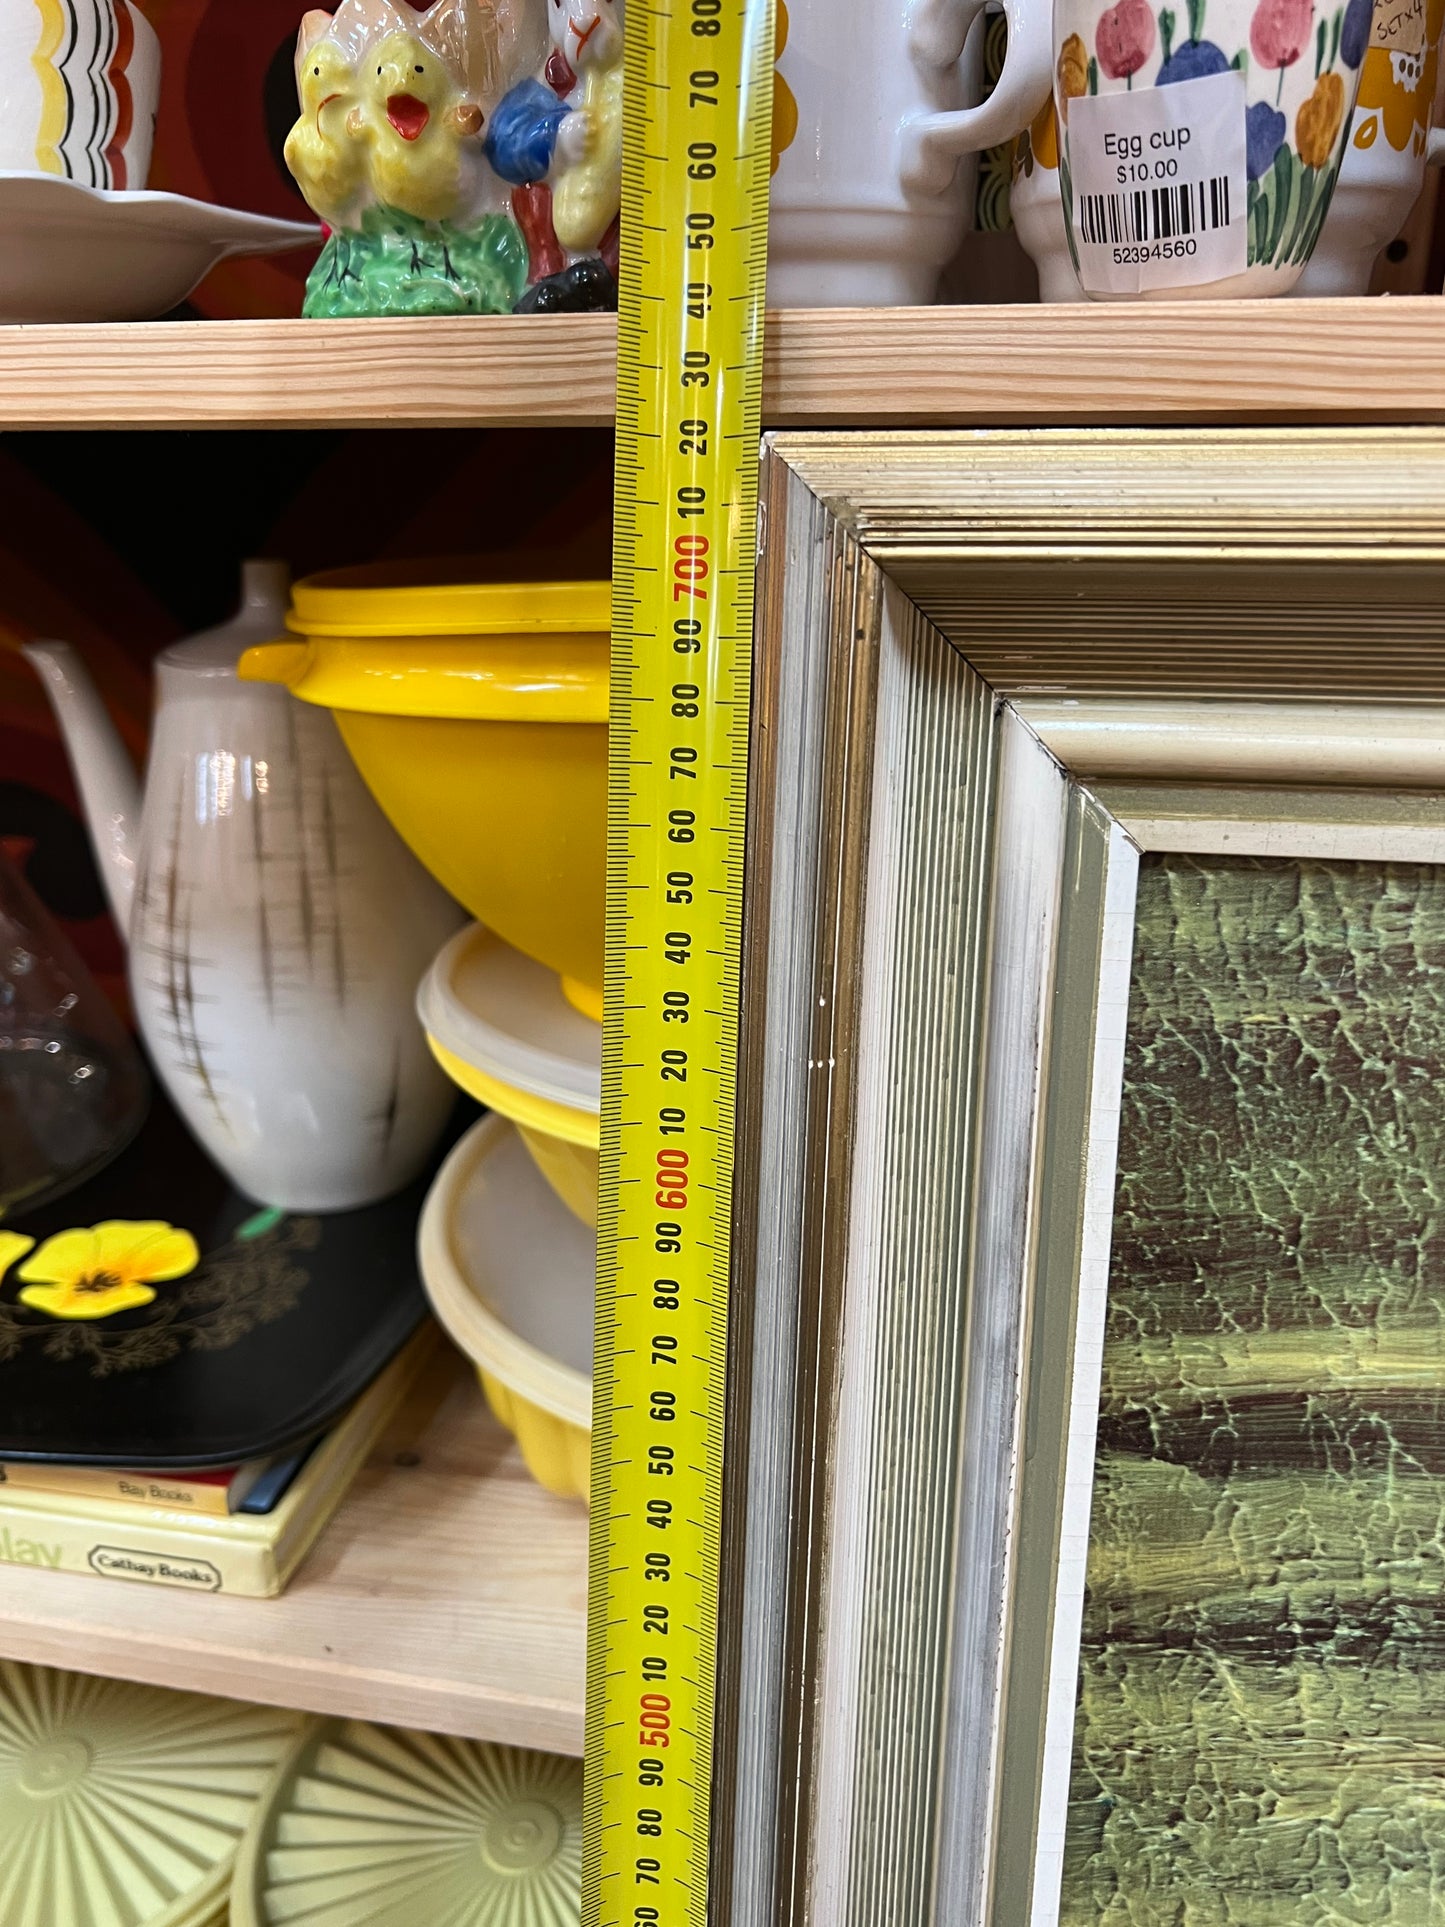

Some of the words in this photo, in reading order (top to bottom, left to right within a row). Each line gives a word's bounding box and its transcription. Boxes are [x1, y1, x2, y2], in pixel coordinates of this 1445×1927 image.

[690, 0, 722, 37] 80
[689, 70, 720, 108] 70
[1103, 131, 1142, 160] Egg
[1150, 125, 1191, 154] cup
[687, 142, 718, 180] 60
[1116, 158, 1179, 184] $10.00
[686, 213, 715, 250] 50
[1113, 238, 1197, 265] 52394560
[686, 282, 713, 320] 40
[681, 351, 711, 388] 30
[678, 419, 708, 456] 20
[677, 486, 706, 519] 10
[673, 534, 710, 603] 700
[673, 619, 702, 654] 90
[671, 683, 700, 718] 80
[669, 747, 698, 780] 70
[667, 809, 696, 843] 60
[666, 871, 694, 905] 50
[664, 931, 692, 965] 40
[662, 991, 690, 1024] 30
[660, 1049, 688, 1083] 20
[659, 1107, 686, 1136] 10
[655, 1148, 690, 1210] 600
[654, 1222, 682, 1254] 90
[653, 1279, 680, 1311] 80
[651, 1335, 678, 1365] 70
[649, 1391, 676, 1422] 60
[647, 1445, 675, 1476] 50
[118, 1480, 146, 1499] Bay
[149, 1484, 194, 1503] Books
[646, 1499, 673, 1530] 40
[0, 1525, 63, 1569] lay
[96, 1552, 157, 1578] Cathay
[157, 1563, 214, 1585] Books
[644, 1552, 671, 1582] 30
[643, 1605, 669, 1635] 20
[641, 1657, 668, 1682] 10
[639, 1693, 671, 1749] 500
[638, 1758, 664, 1787] 90
[636, 1808, 662, 1837] 80
[635, 1858, 661, 1885] 70
